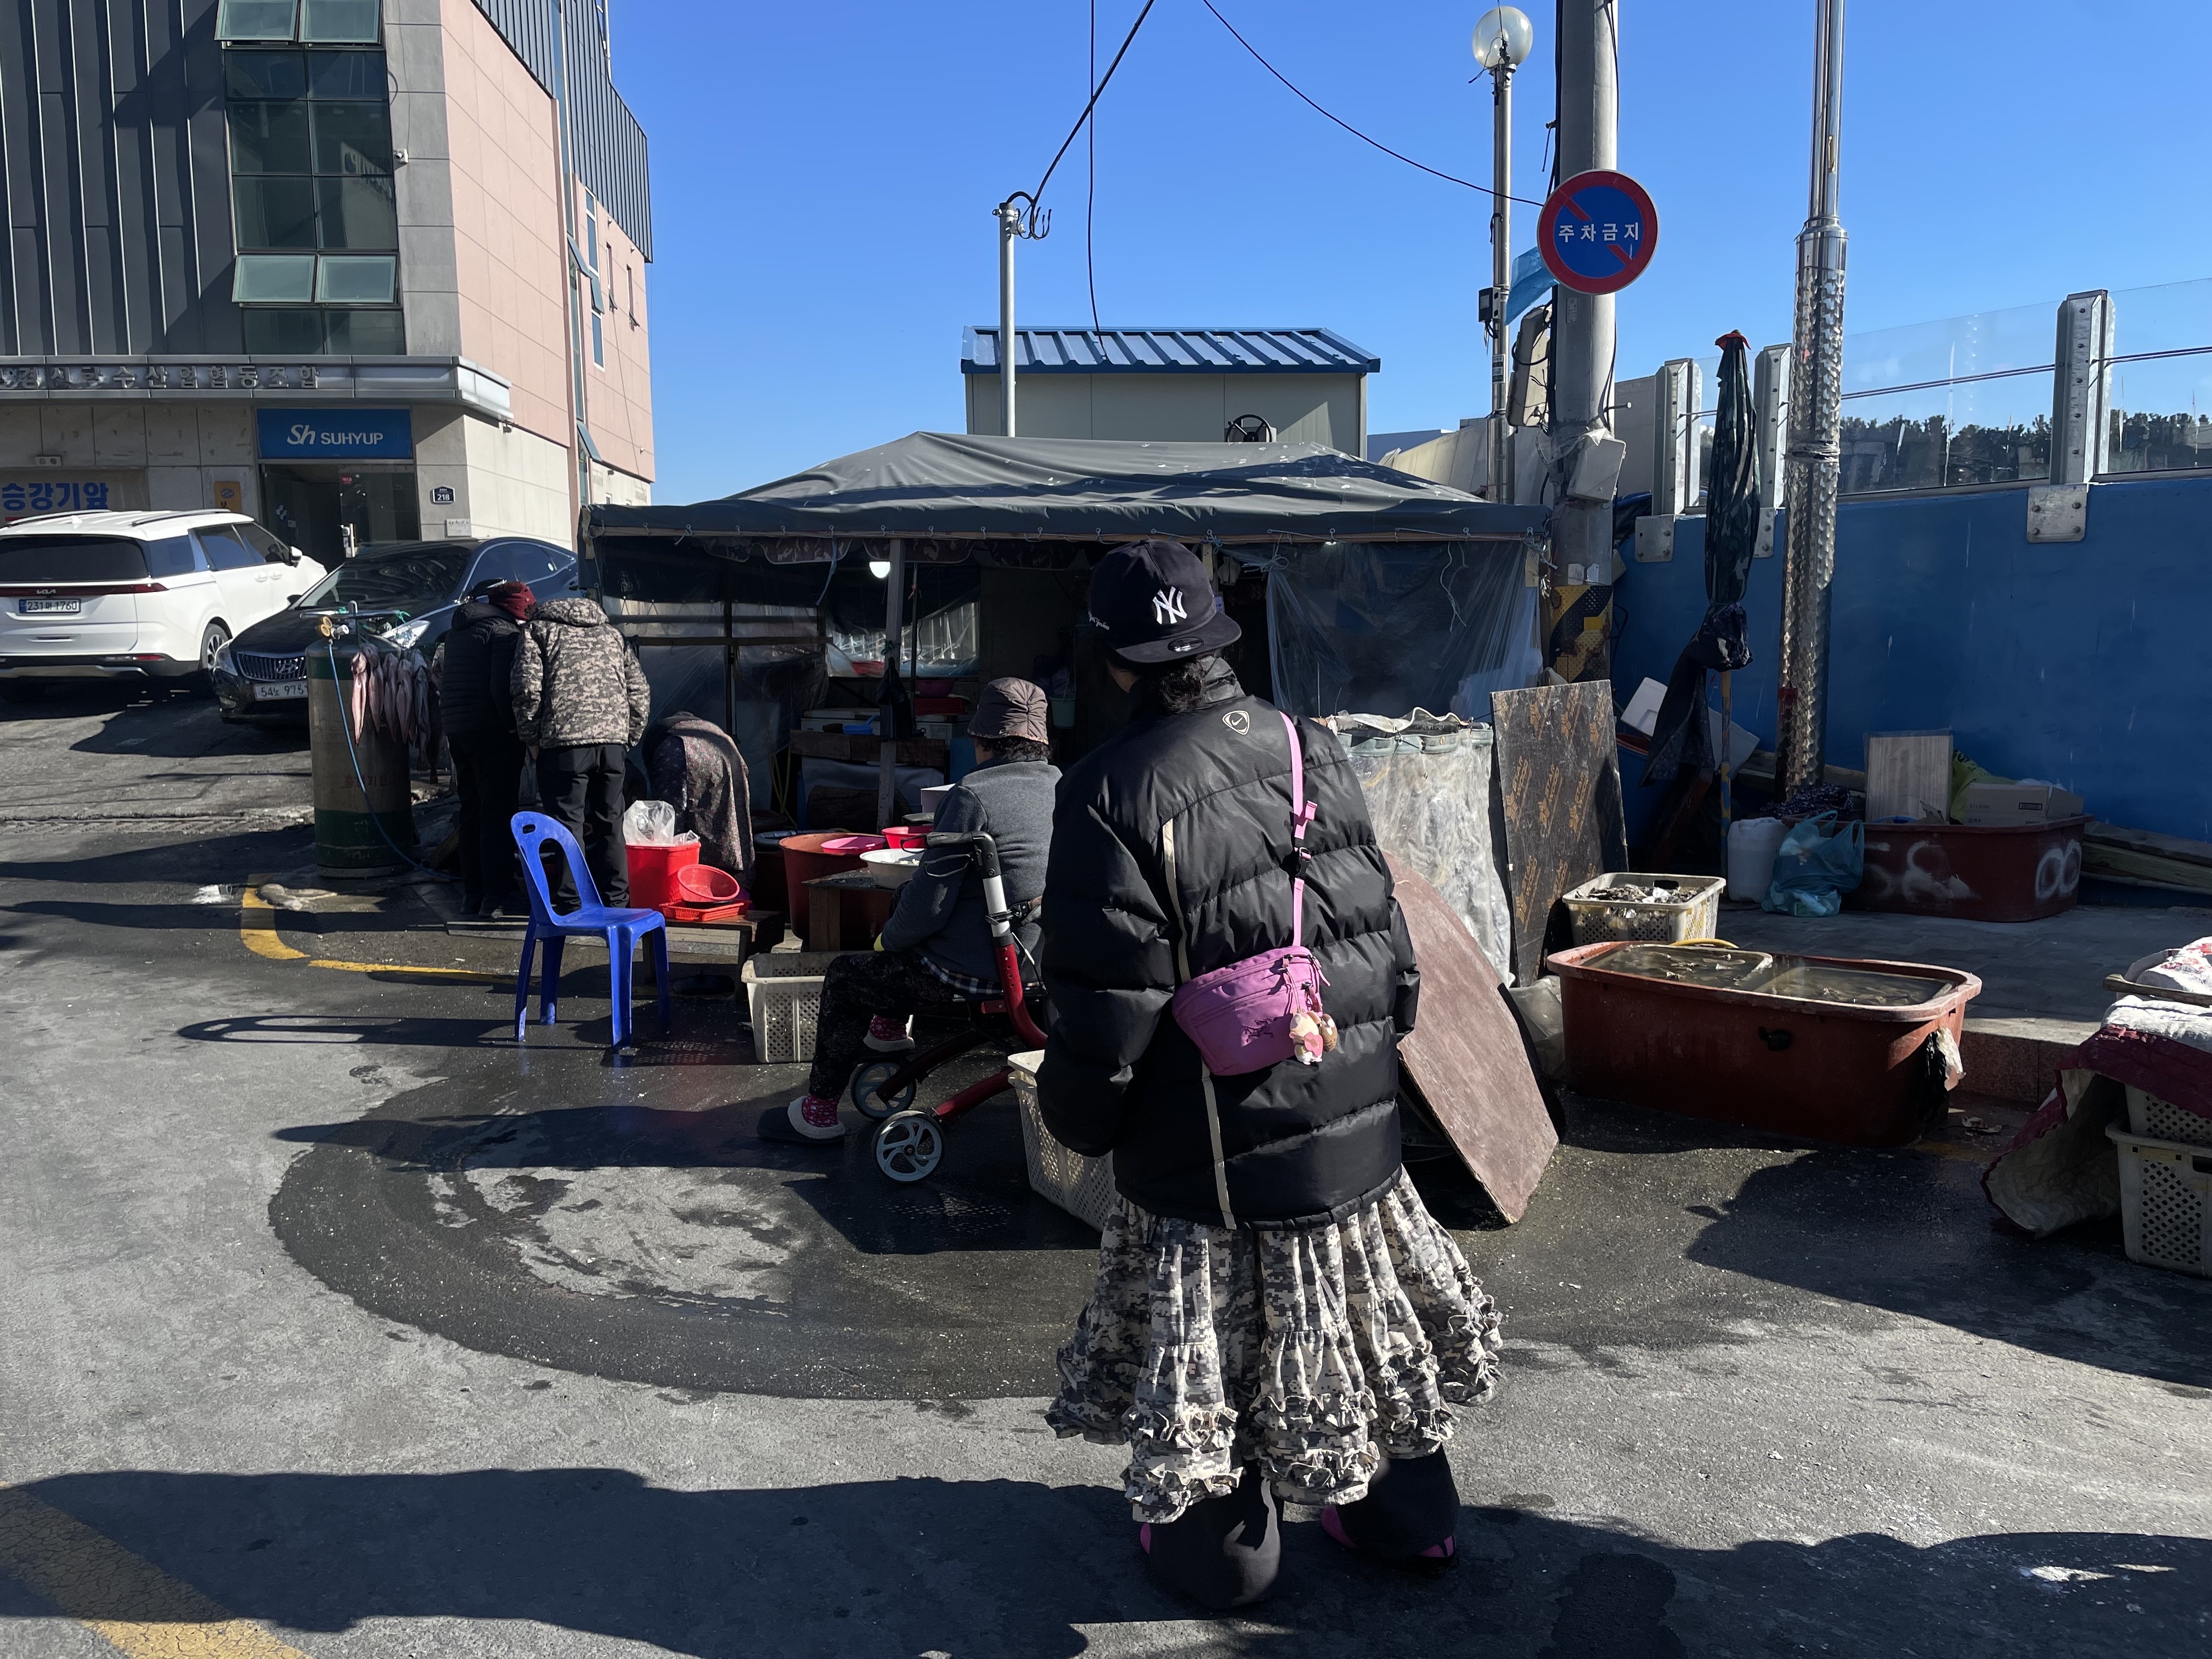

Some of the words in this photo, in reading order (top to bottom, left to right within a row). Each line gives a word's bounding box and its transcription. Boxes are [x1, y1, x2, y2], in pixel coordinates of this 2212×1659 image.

[1559, 222, 1639, 243] 주차금지
[287, 424, 316, 445] Sh
[320, 432, 383, 445] SUHYUP
[2, 482, 109, 511] 승강기앞
[55, 601, 77, 610] 1760
[1153, 586, 1187, 624] NY
